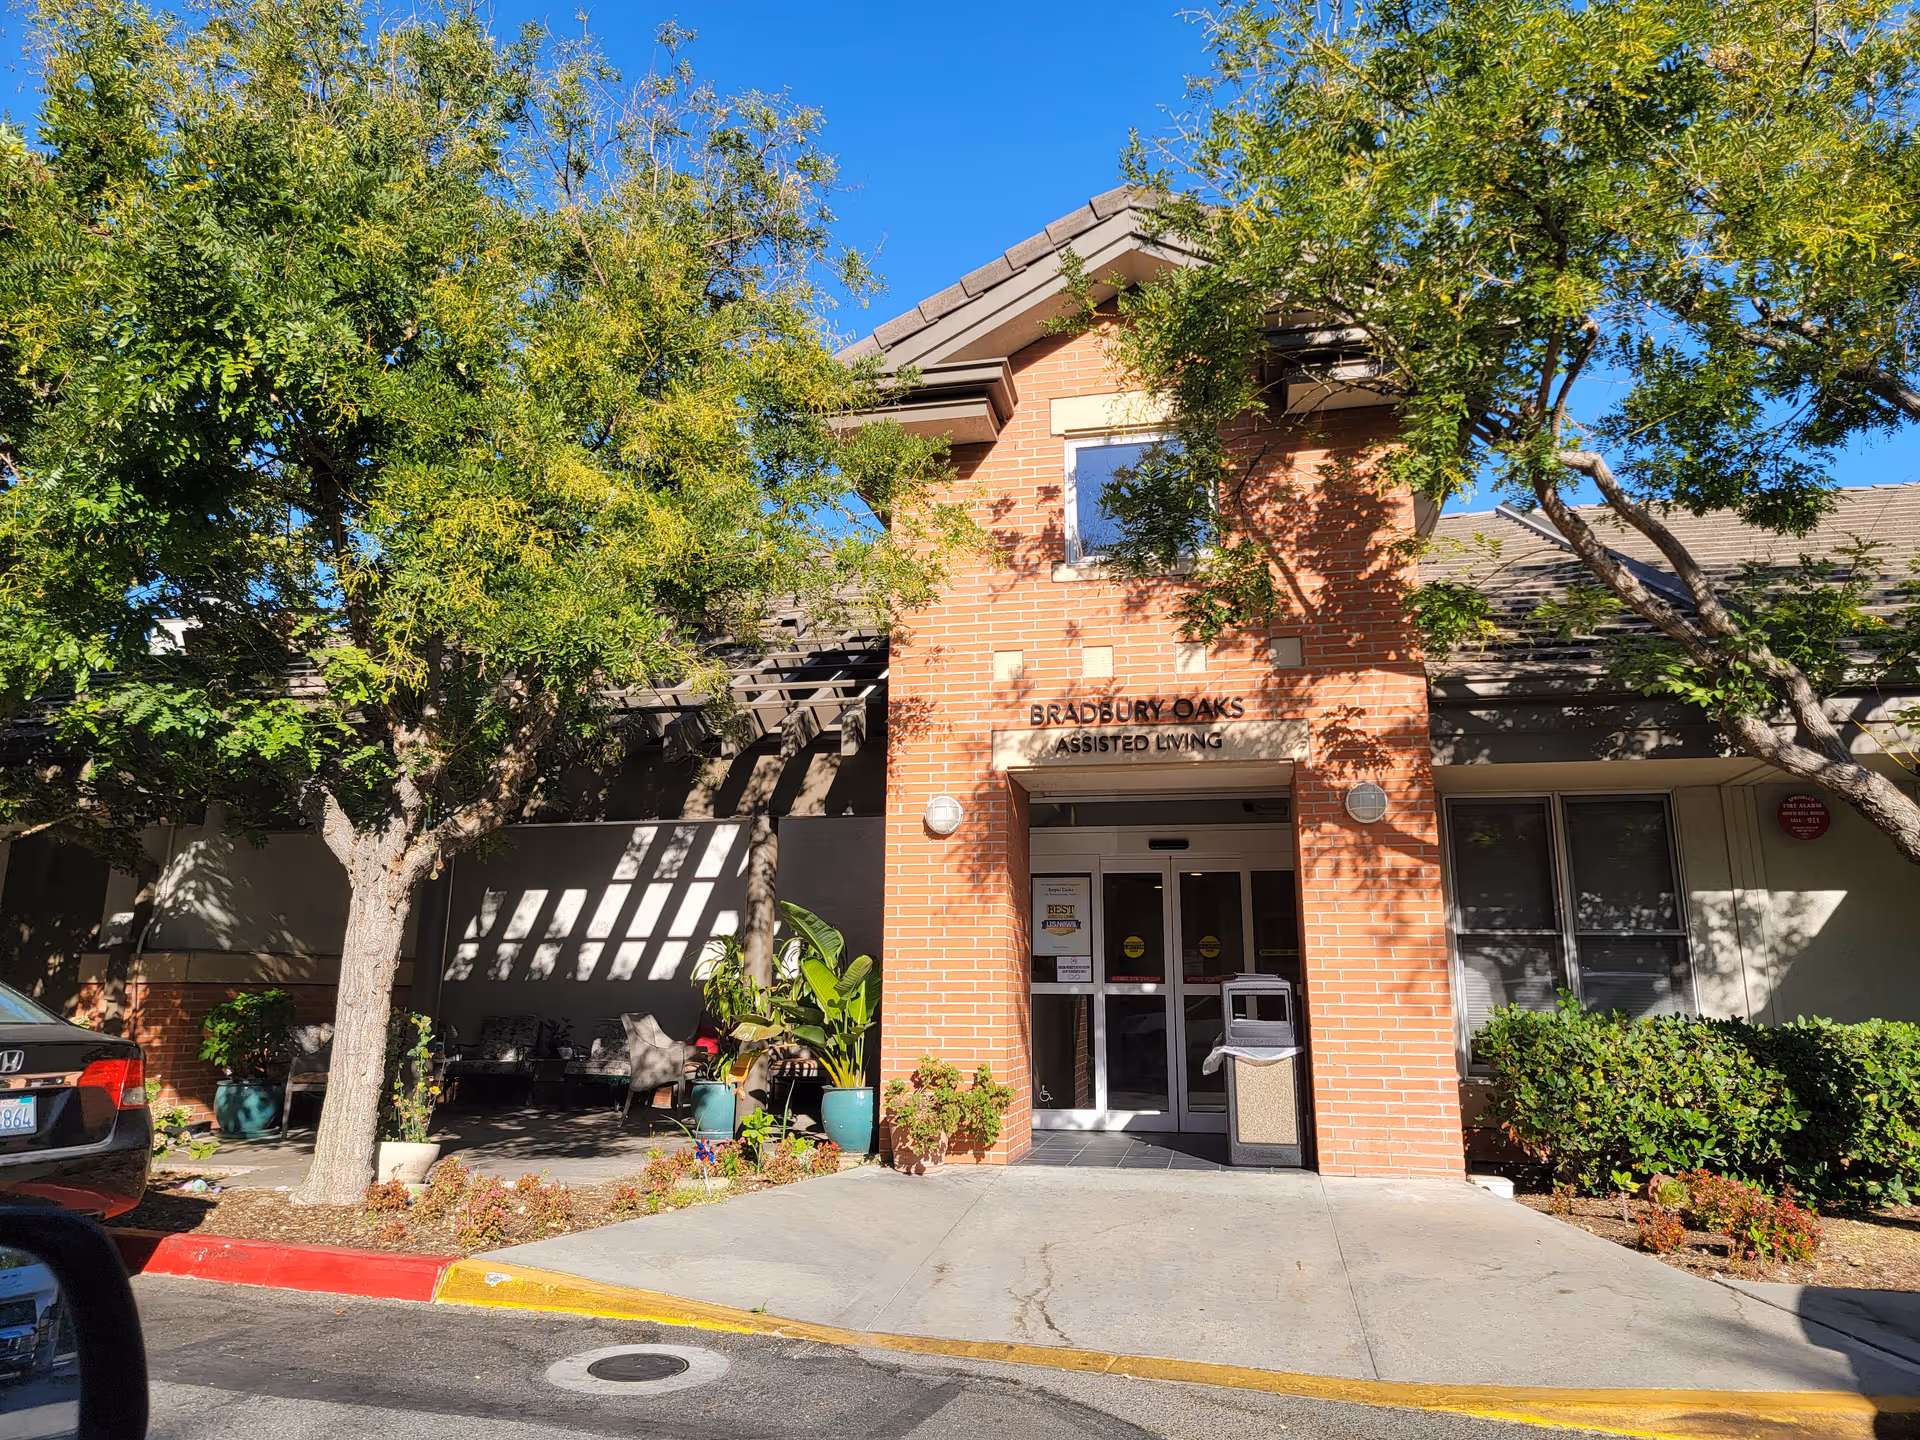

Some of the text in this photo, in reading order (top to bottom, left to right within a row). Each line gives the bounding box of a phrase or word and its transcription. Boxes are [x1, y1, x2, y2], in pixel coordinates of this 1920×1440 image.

[1030, 696, 1246, 726] BRADBURY OAKS
[1055, 732, 1223, 754] ASSISTED LIVING
[1047, 904, 1075, 914] BEST
[0, 1108, 31, 1128] 864
